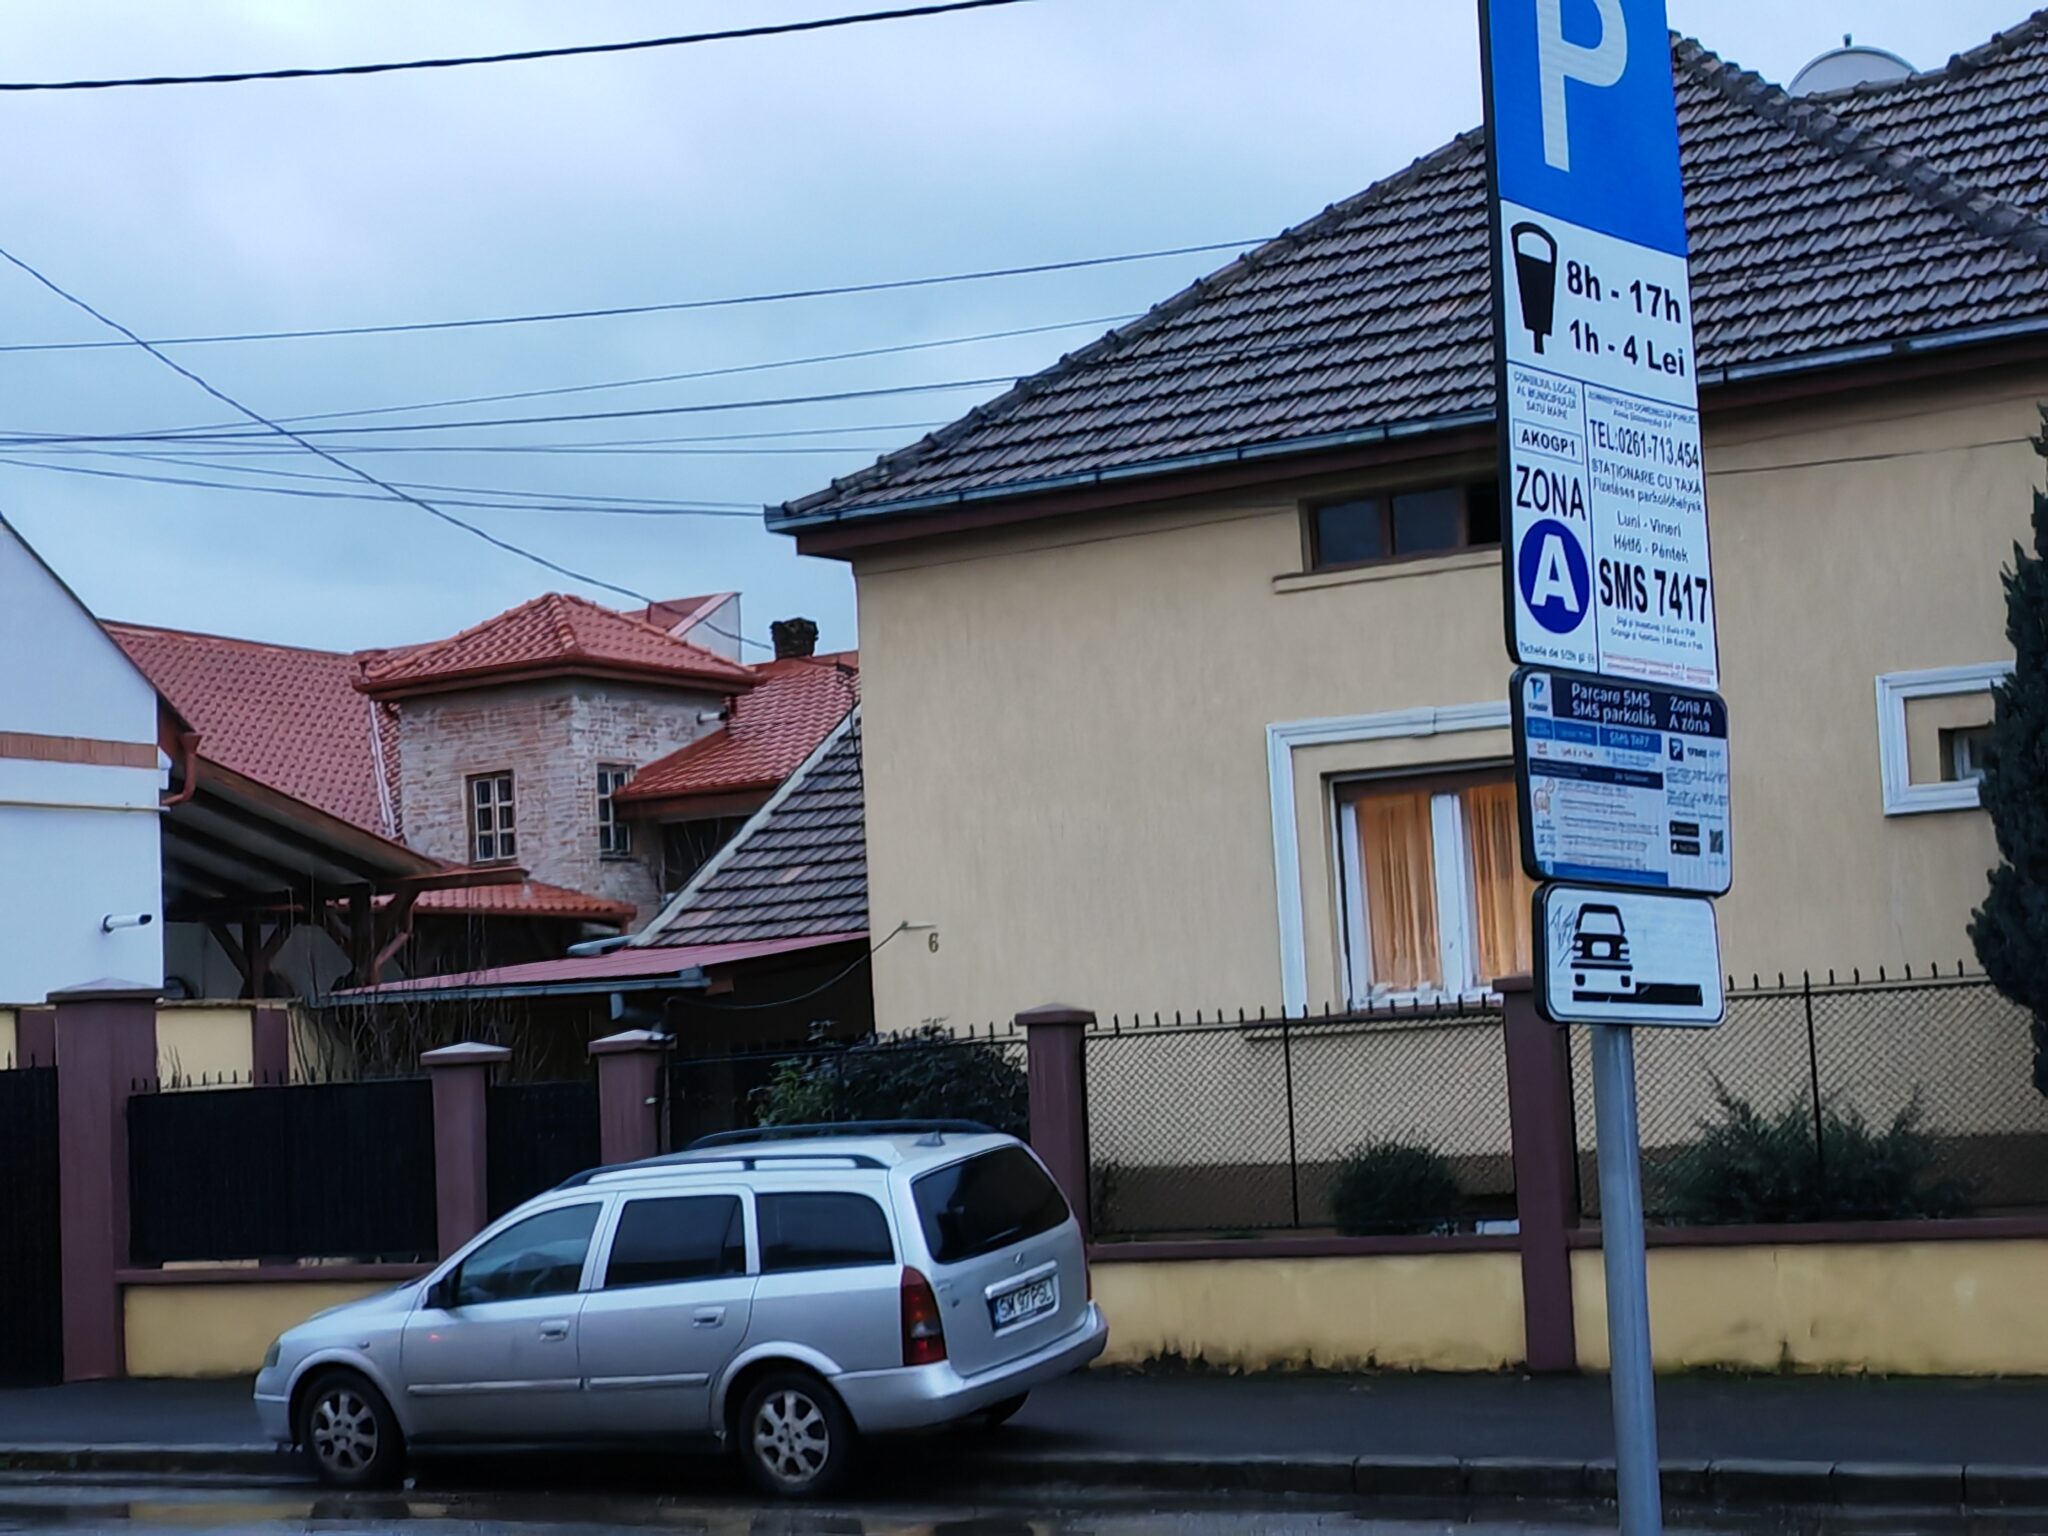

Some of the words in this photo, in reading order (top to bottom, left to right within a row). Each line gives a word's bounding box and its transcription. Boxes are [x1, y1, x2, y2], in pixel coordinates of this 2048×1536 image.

[1536, 0, 1628, 173] P
[1567, 260, 1601, 302] 8h
[1630, 280, 1681, 323] 17h
[1569, 319, 1599, 354] 1h
[1623, 335, 1639, 365] 4
[1647, 340, 1685, 376] Lei
[1516, 464, 1586, 521] ZONA
[1657, 473, 1673, 490] CU
[1530, 533, 1580, 613] A
[1599, 557, 1648, 613] SMS
[1654, 568, 1707, 624] 7417
[1571, 682, 1621, 704] Parcare
[1623, 689, 1651, 708] SMS
[1572, 699, 1600, 719] SMS
[1669, 695, 1700, 715] Zona
[1703, 701, 1712, 717] A
[1669, 713, 1679, 729] A
[928, 932, 940, 954] 6
